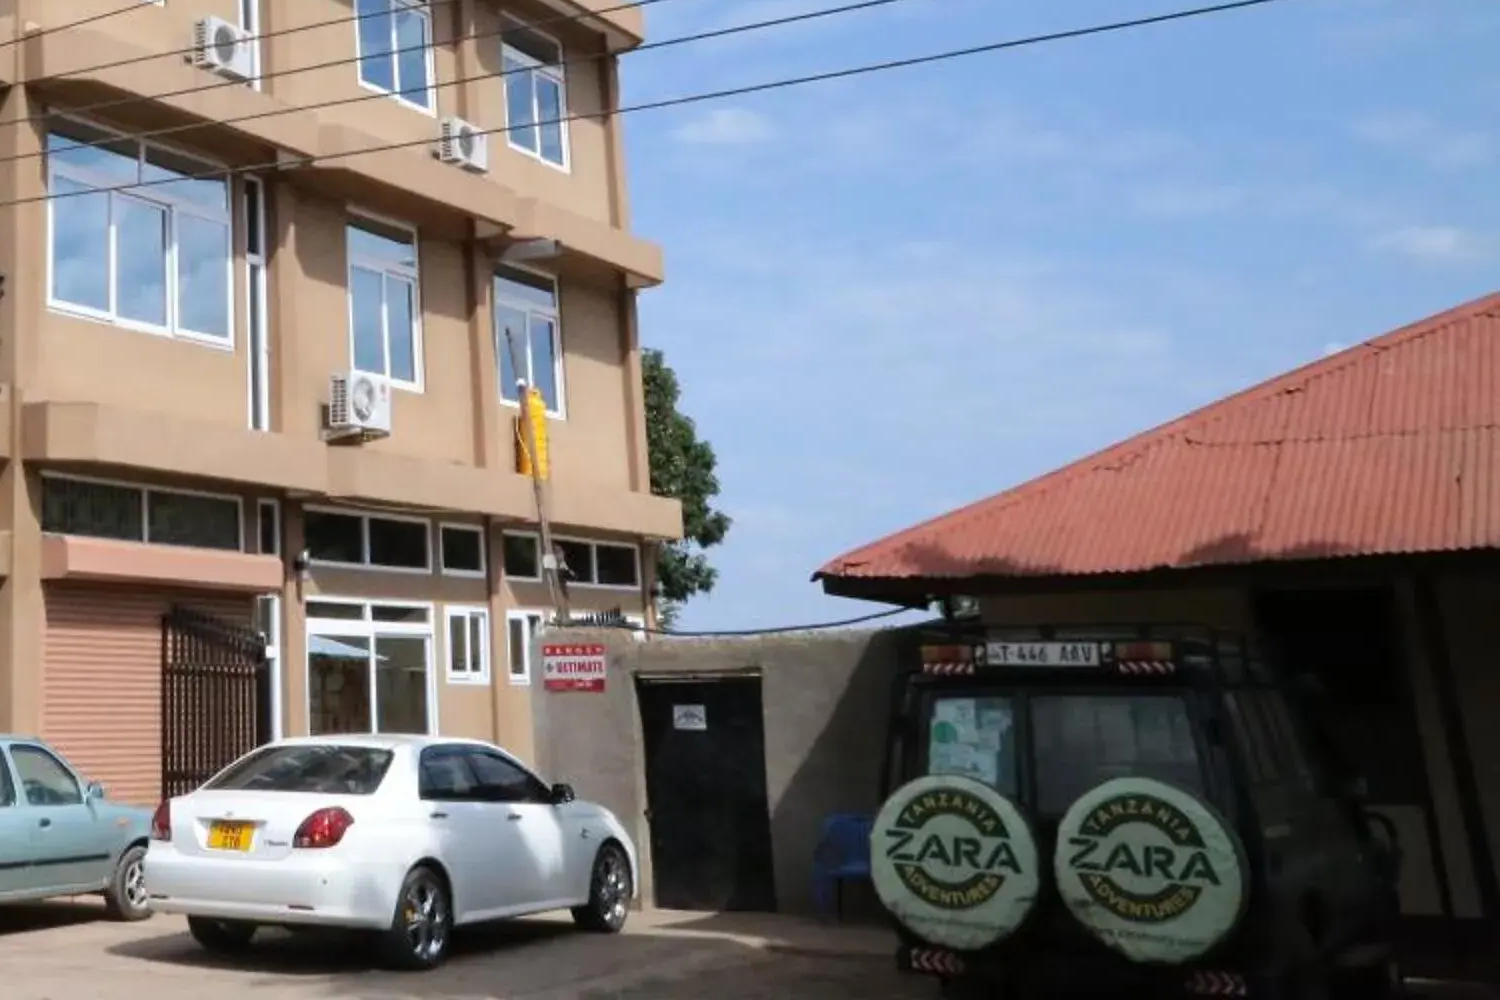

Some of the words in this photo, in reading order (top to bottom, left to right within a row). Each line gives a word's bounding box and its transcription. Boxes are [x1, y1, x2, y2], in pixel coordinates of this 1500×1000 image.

[902, 792, 998, 832] TANZANIA
[1087, 799, 1191, 841] TANZANIA
[885, 829, 1023, 876] ZARA
[1068, 837, 1222, 887] ZARA
[903, 864, 999, 904] ADVENTURES
[1088, 875, 1195, 918] ADVENTURES
